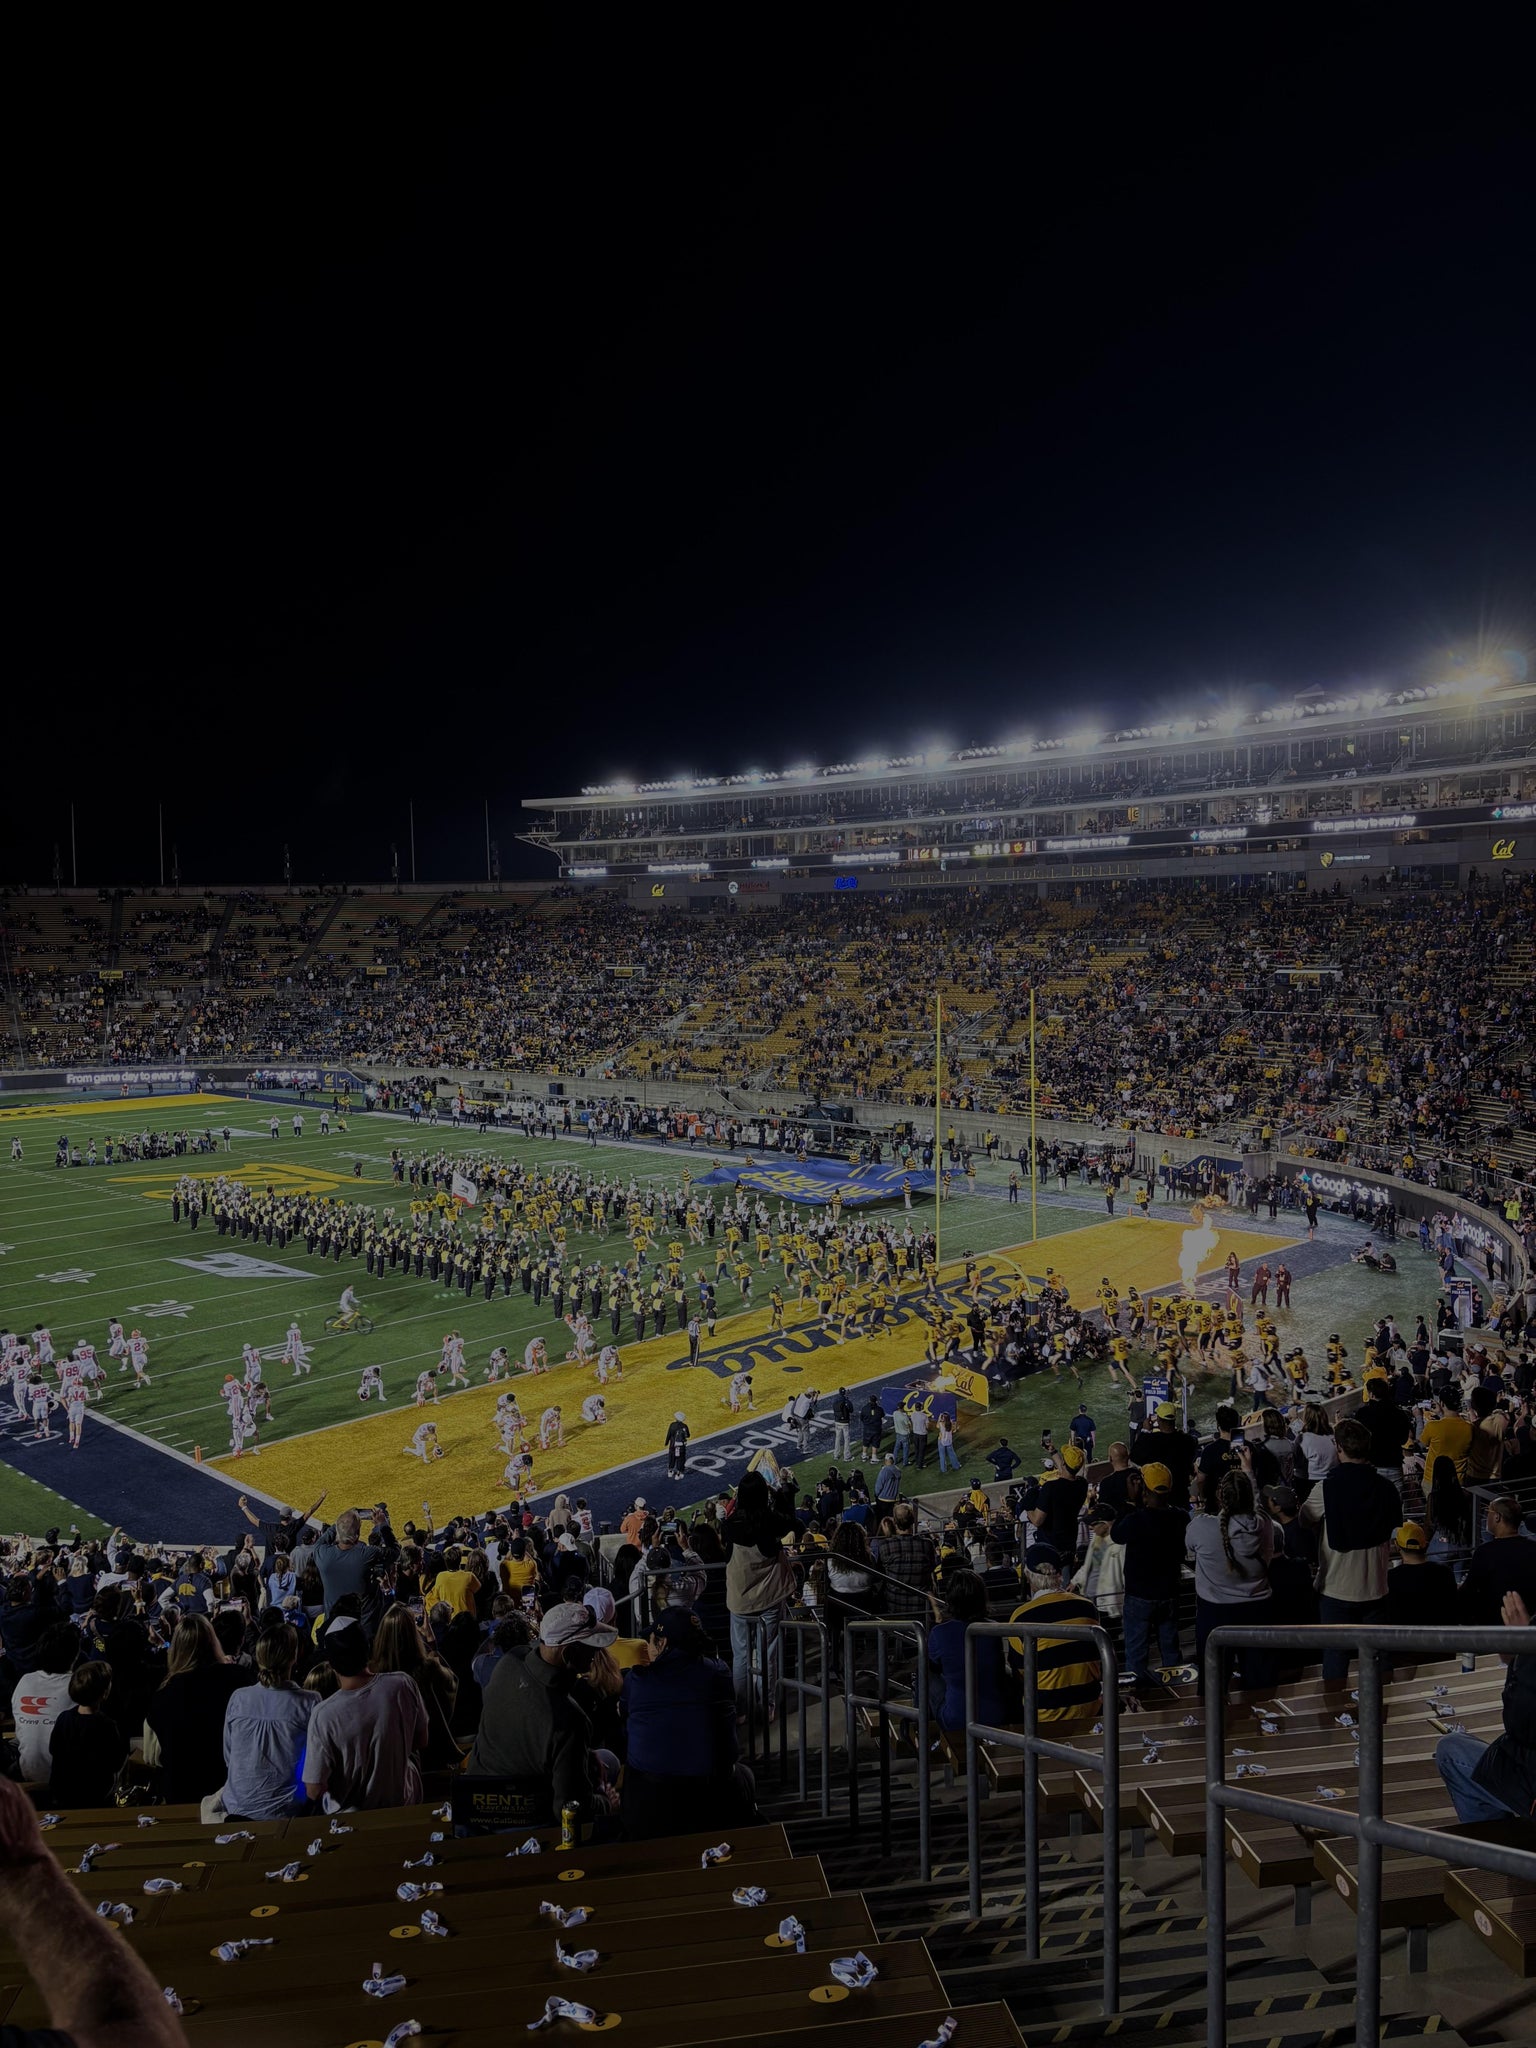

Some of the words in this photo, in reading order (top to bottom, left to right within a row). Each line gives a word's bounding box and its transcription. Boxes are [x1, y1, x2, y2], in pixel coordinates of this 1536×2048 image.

[1503, 806, 1532, 817] Google
[1313, 821, 1334, 831] From
[1492, 839, 1516, 859] Cal
[652, 884, 665, 897] Cal
[67, 1074, 92, 1083] From
[94, 1074, 120, 1084] game
[121, 1072, 139, 1083] day
[140, 1071, 150, 1080] to
[151, 1071, 177, 1081] every
[1311, 1172, 1351, 1197] Google
[1461, 1216, 1485, 1247] Google
[134, 1342, 141, 1351] 2
[79, 1349, 92, 1360] 95
[18, 1369, 25, 1380] 2
[65, 1366, 80, 1377] 89
[33, 1388, 47, 1399] 25
[75, 1390, 85, 1401] 14
[567, 1871, 575, 1879] 2
[401, 1928, 410, 1936] 3
[825, 1989, 833, 1999] 1
